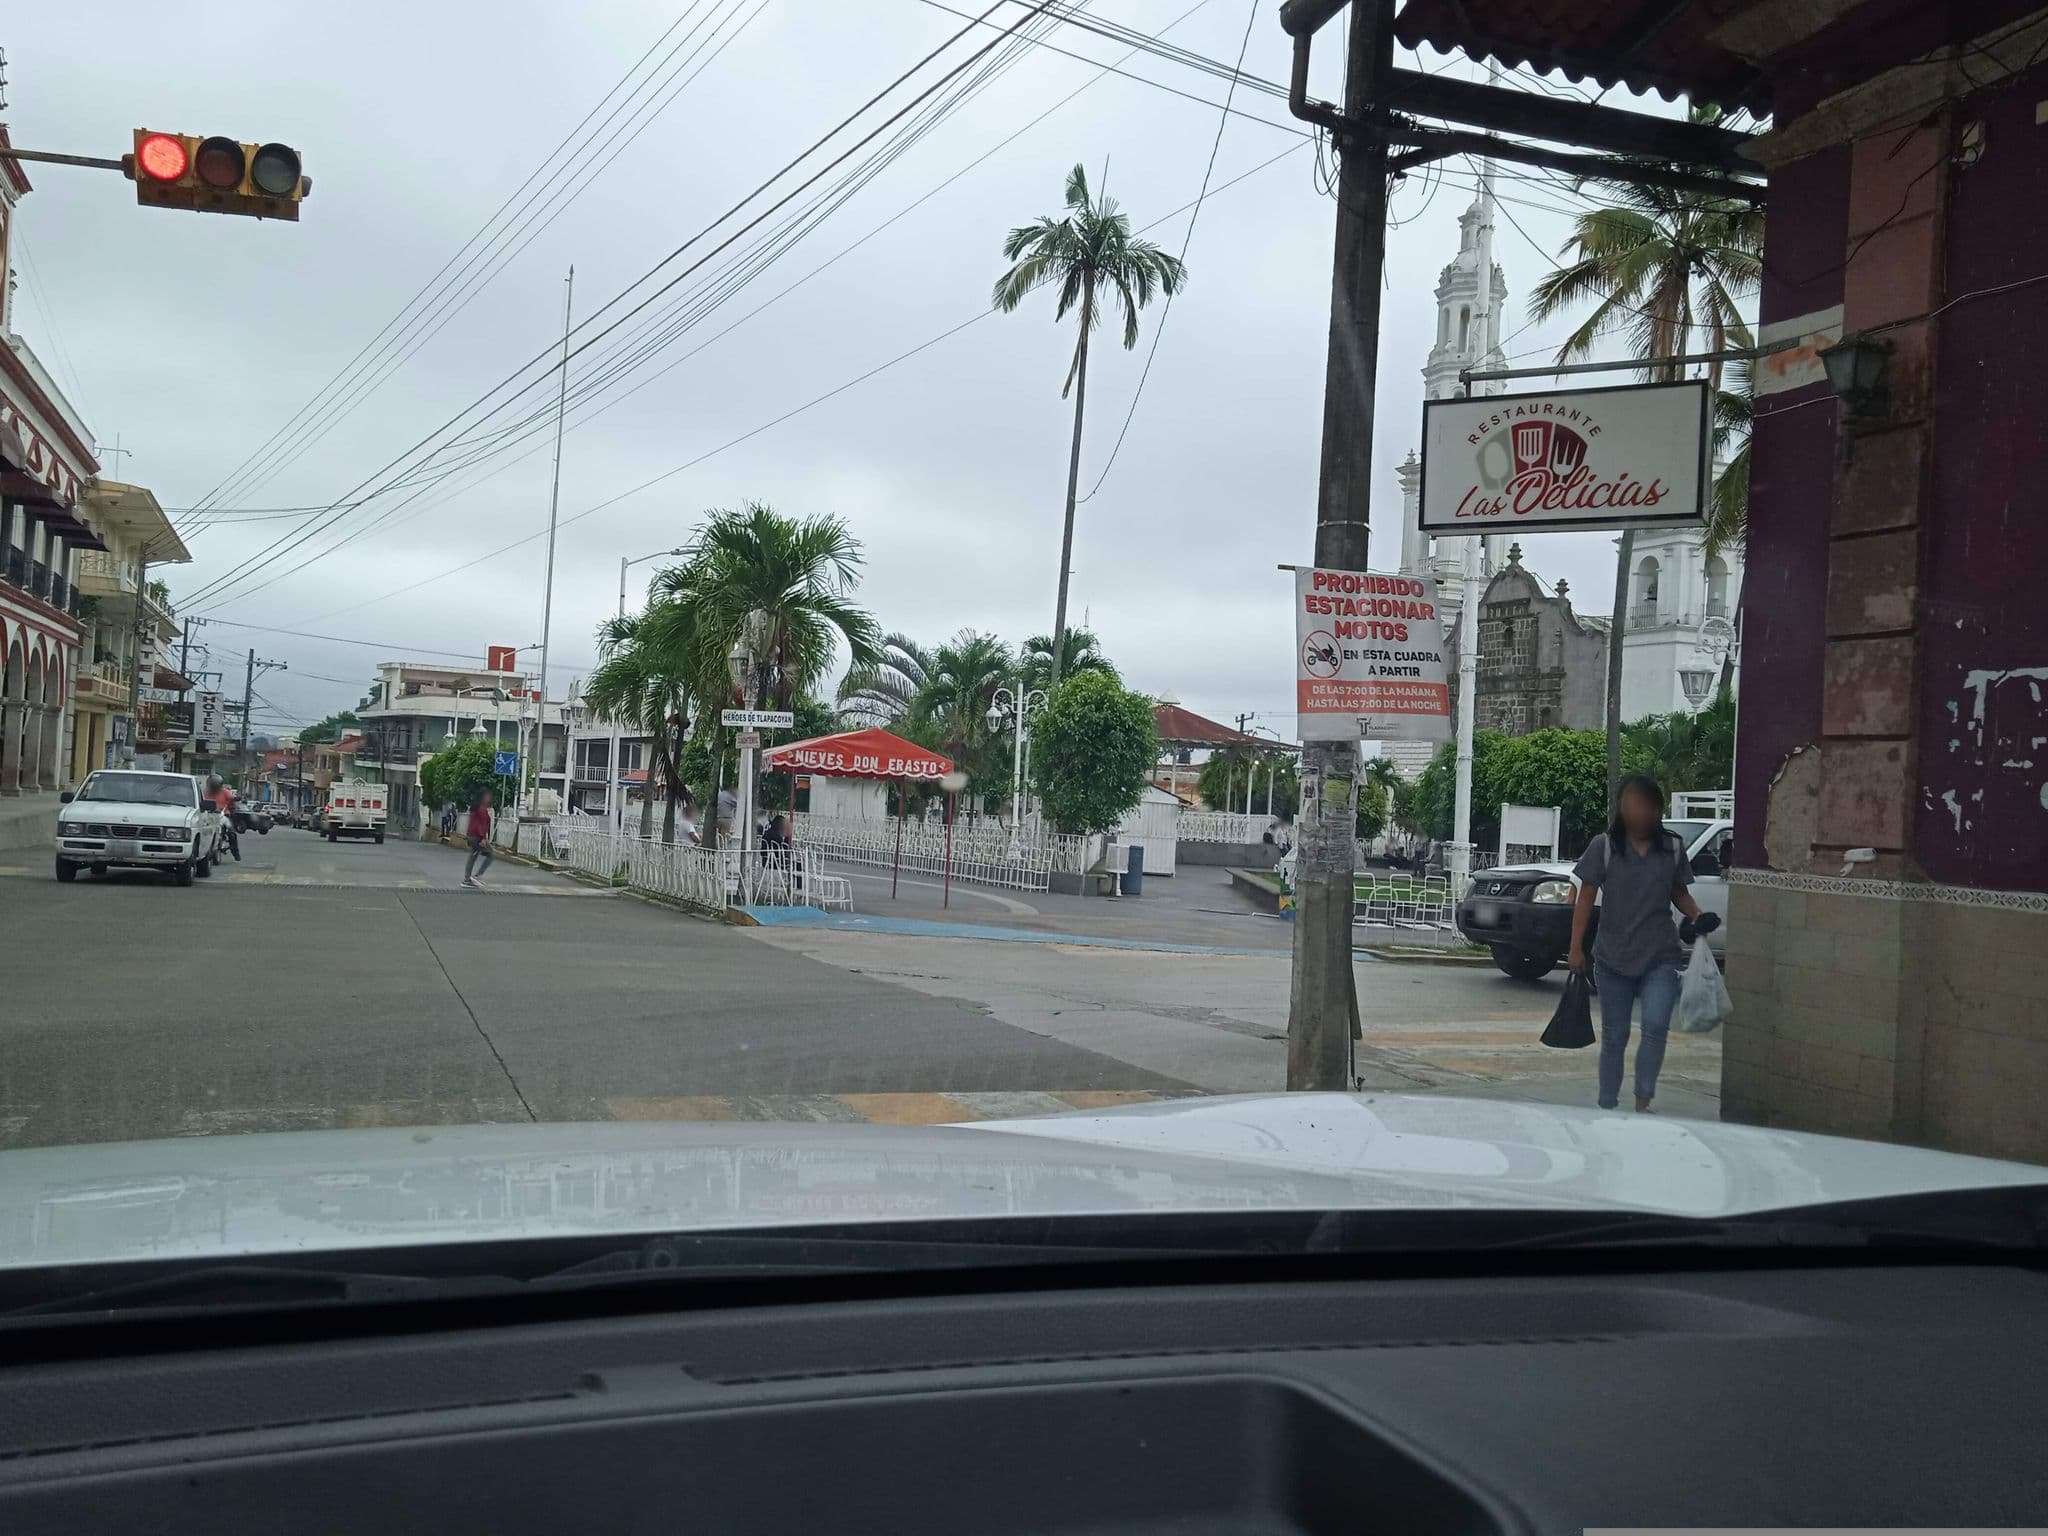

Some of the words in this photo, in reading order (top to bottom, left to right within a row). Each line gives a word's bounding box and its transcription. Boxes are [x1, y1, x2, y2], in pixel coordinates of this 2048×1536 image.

[1467, 403, 1602, 445] RESTAURANTE
[1456, 486, 1507, 518] Las
[1505, 465, 1670, 515] Delicias
[1313, 572, 1424, 597] PROHIBIDO
[1304, 595, 1436, 620] ESTACIONAR
[1334, 620, 1408, 642] MOTOS
[1343, 650, 1359, 660] EN
[1363, 650, 1391, 661] ESTA
[1394, 651, 1441, 663] CUADRA
[1368, 665, 1376, 675] A
[1379, 666, 1421, 677] PARTIR
[138, 688, 171, 700] PLAZA
[1312, 685, 1326, 695] DE
[1327, 686, 1345, 695] LAS
[1345, 686, 1368, 695] 7:00
[1369, 686, 1382, 695] DE
[1383, 687, 1395, 696] LA
[1396, 685, 1438, 697] MAÑANA
[203, 696, 216, 732] HOTEL
[1307, 699, 1341, 708] HASTA
[1341, 700, 1359, 708] LAS
[1360, 699, 1382, 709] 7:00
[1383, 700, 1397, 709] DE
[1397, 700, 1410, 709] LA
[1410, 700, 1442, 711] NOCHE
[748, 714, 756, 722] DE
[757, 714, 792, 724] TLAPACOYAN
[795, 751, 844, 766] NIEVES
[854, 756, 878, 770] DON
[888, 758, 937, 773] ERASTO
